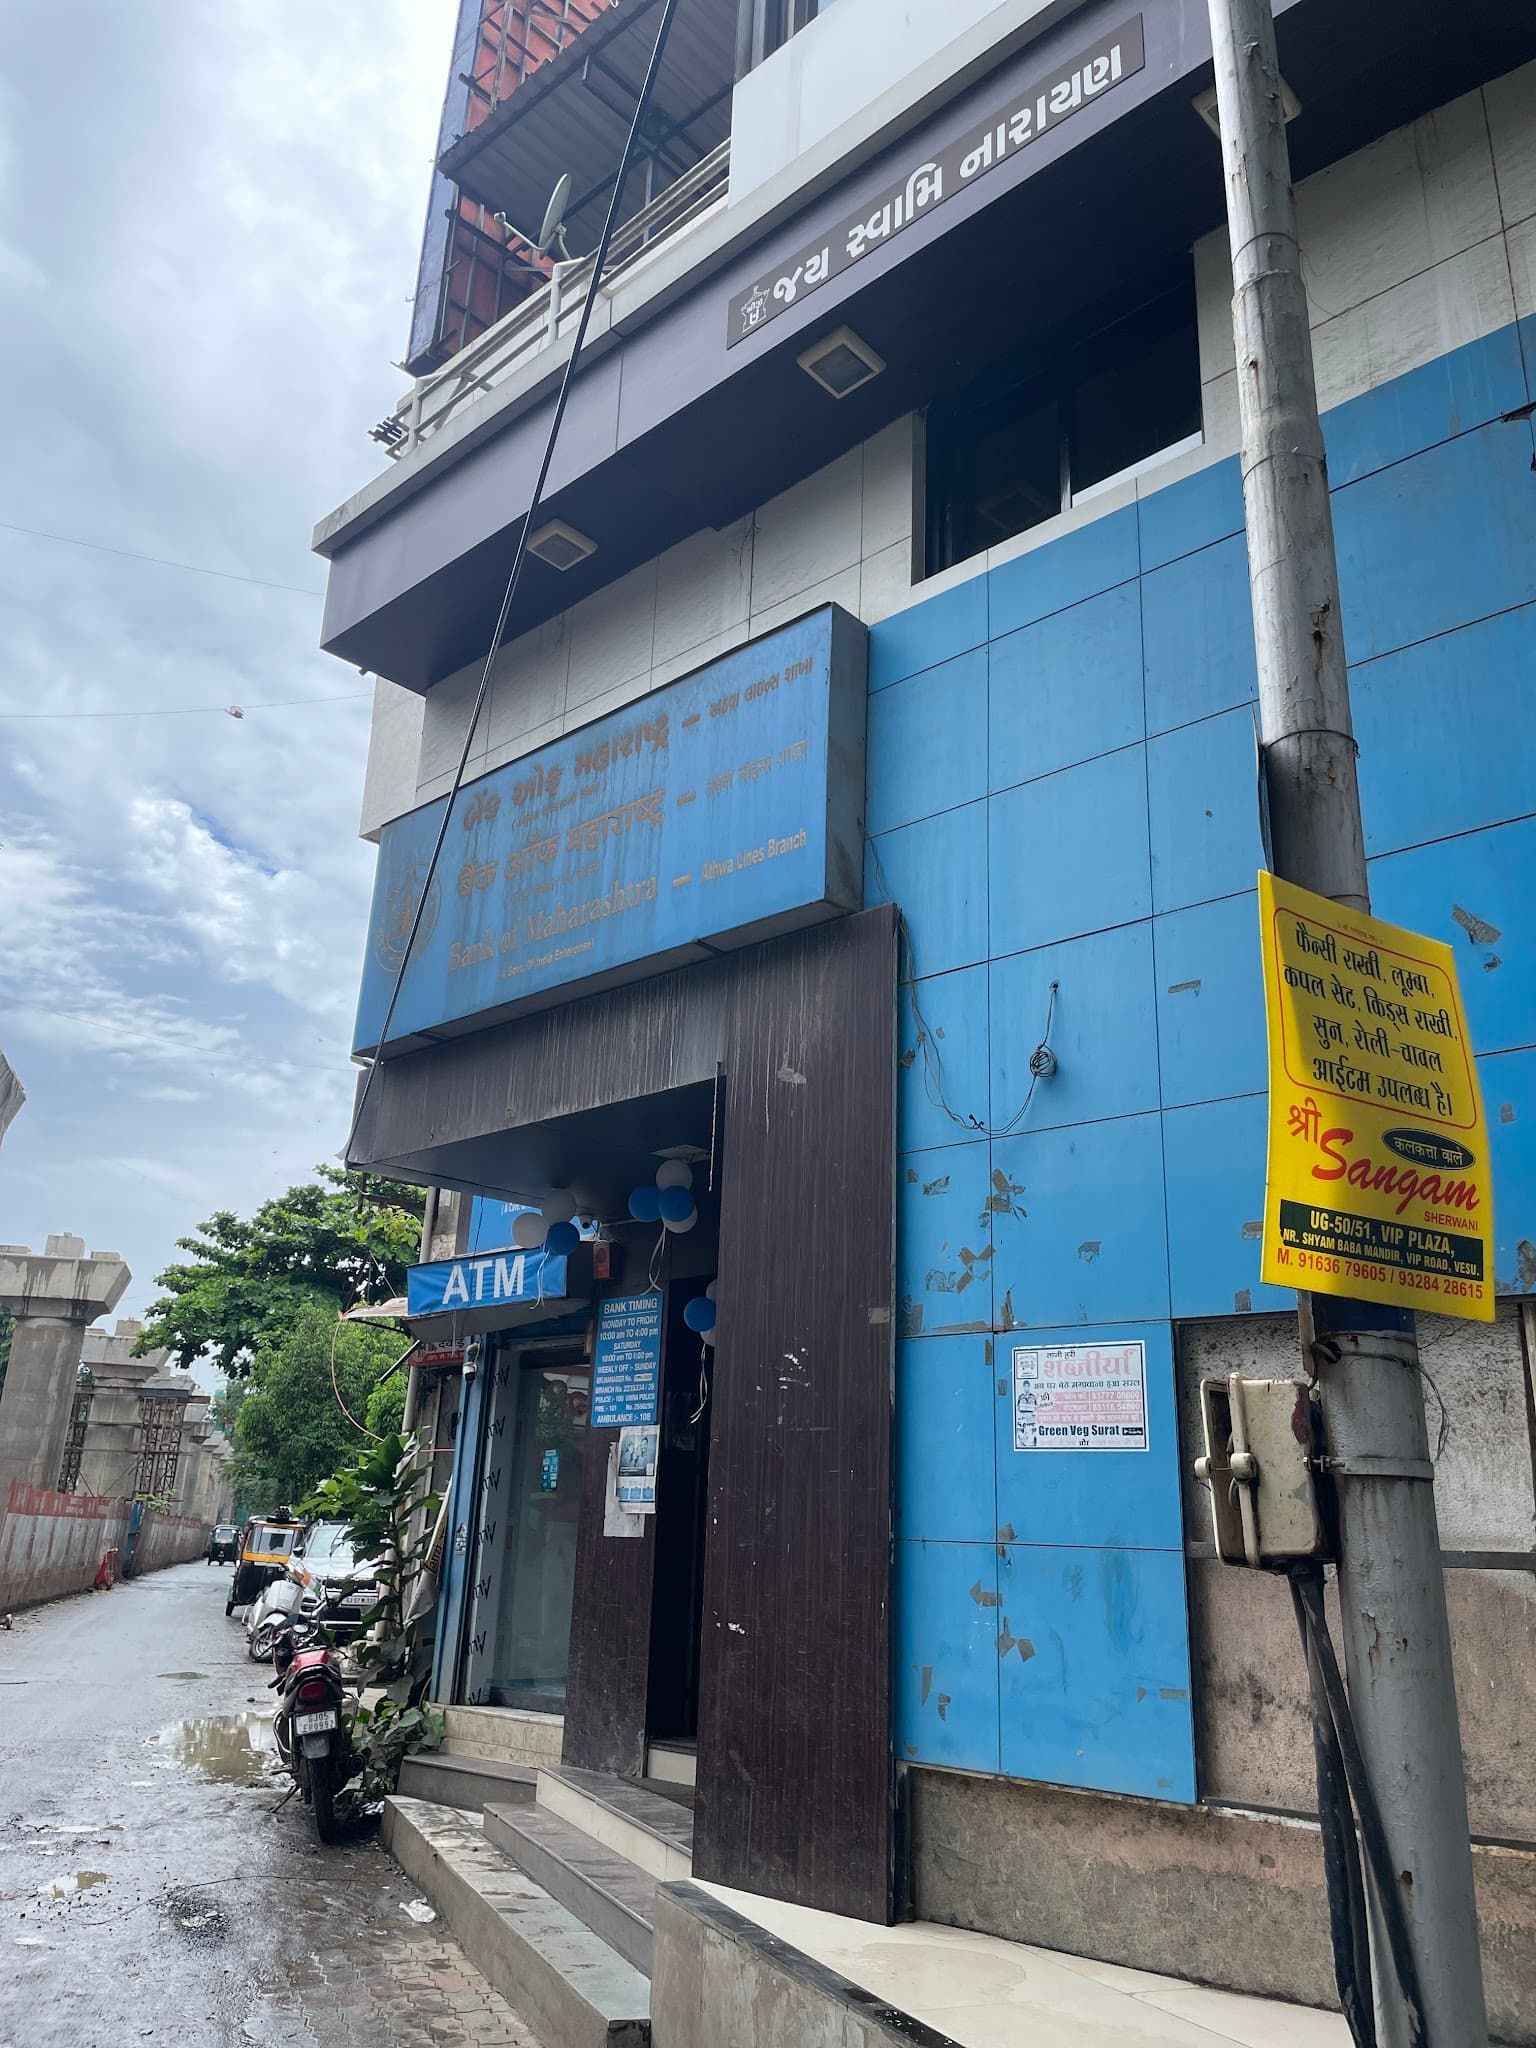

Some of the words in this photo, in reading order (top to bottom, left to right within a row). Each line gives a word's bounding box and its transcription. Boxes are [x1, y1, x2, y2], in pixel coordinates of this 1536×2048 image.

[773, 247, 828, 303] જય
[846, 162, 943, 257] સ્વામિ
[959, 44, 1122, 178] નારાયણ
[566, 789, 667, 852] महाराष्ट्र
[449, 928, 496, 972] Bank
[501, 916, 522, 952] of
[526, 877, 657, 944] Maharashtra
[702, 858, 733, 881] Athwa
[736, 847, 764, 871] Lines
[768, 824, 806, 858] Branch
[1296, 922, 1337, 965] फैन्सी
[1343, 948, 1386, 983] राखी,
[1390, 965, 1435, 999] लूम्बा,
[1283, 964, 1326, 999] कपल
[1330, 973, 1361, 1012] सेट,
[1365, 986, 1410, 1031] किड्स
[1412, 1009, 1458, 1041] राखी,
[1313, 1056, 1371, 1093] आईटम
[1376, 1074, 1431, 1110] उपलब्ध
[1431, 1082, 1453, 1116] है।
[1288, 1096, 1322, 1144] श्री
[1312, 1127, 1480, 1215] Sangam
[1393, 1136, 1437, 1161] कलकत्ता
[1441, 1147, 1463, 1167] वाले
[1310, 1210, 1376, 1243] UG-50/51,
[1381, 1224, 1404, 1244] VIP
[1408, 1230, 1455, 1257] PLAZA,
[1424, 1211, 1477, 1231] SHERWANI
[1277, 1248, 1293, 1266] M.
[1298, 1252, 1340, 1274] 91636
[1345, 1261, 1386, 1282] 79605
[1399, 1270, 1439, 1291] 93284
[1443, 1279, 1483, 1299] 28615
[1283, 1228, 1299, 1243] NR.
[1302, 1232, 1335, 1250] SHYAM
[1337, 1239, 1361, 1256] BABA
[1364, 1244, 1403, 1264] MANDIR,
[1406, 1252, 1421, 1266] VIP
[1424, 1256, 1451, 1273] ROAD,
[1454, 1261, 1480, 1276] VESU.
[442, 1255, 525, 1304] ATM
[602, 1318, 626, 1329] MONDAY
[628, 1317, 635, 1326] TO
[636, 1315, 658, 1325] FRIDAY
[604, 1301, 626, 1314] BANK
[628, 1298, 658, 1311] TIMING
[600, 1331, 615, 1340] 10:00
[626, 1329, 634, 1337] TO
[635, 1327, 648, 1336] 4:00
[613, 1341, 641, 1350] SATURDAY
[625, 1352, 632, 1360] TO
[598, 1364, 618, 1374] WEEKLY
[618, 1363, 630, 1372] OFF
[634, 1361, 656, 1371] SUNDAY
[595, 1395, 611, 1404] POLICE
[597, 1413, 633, 1424] AMBULANCE
[640, 1412, 651, 1421] 108
[1039, 1425, 1068, 1436] Green
[1070, 1424, 1089, 1437] Veg
[1091, 1424, 1119, 1436] Surat
